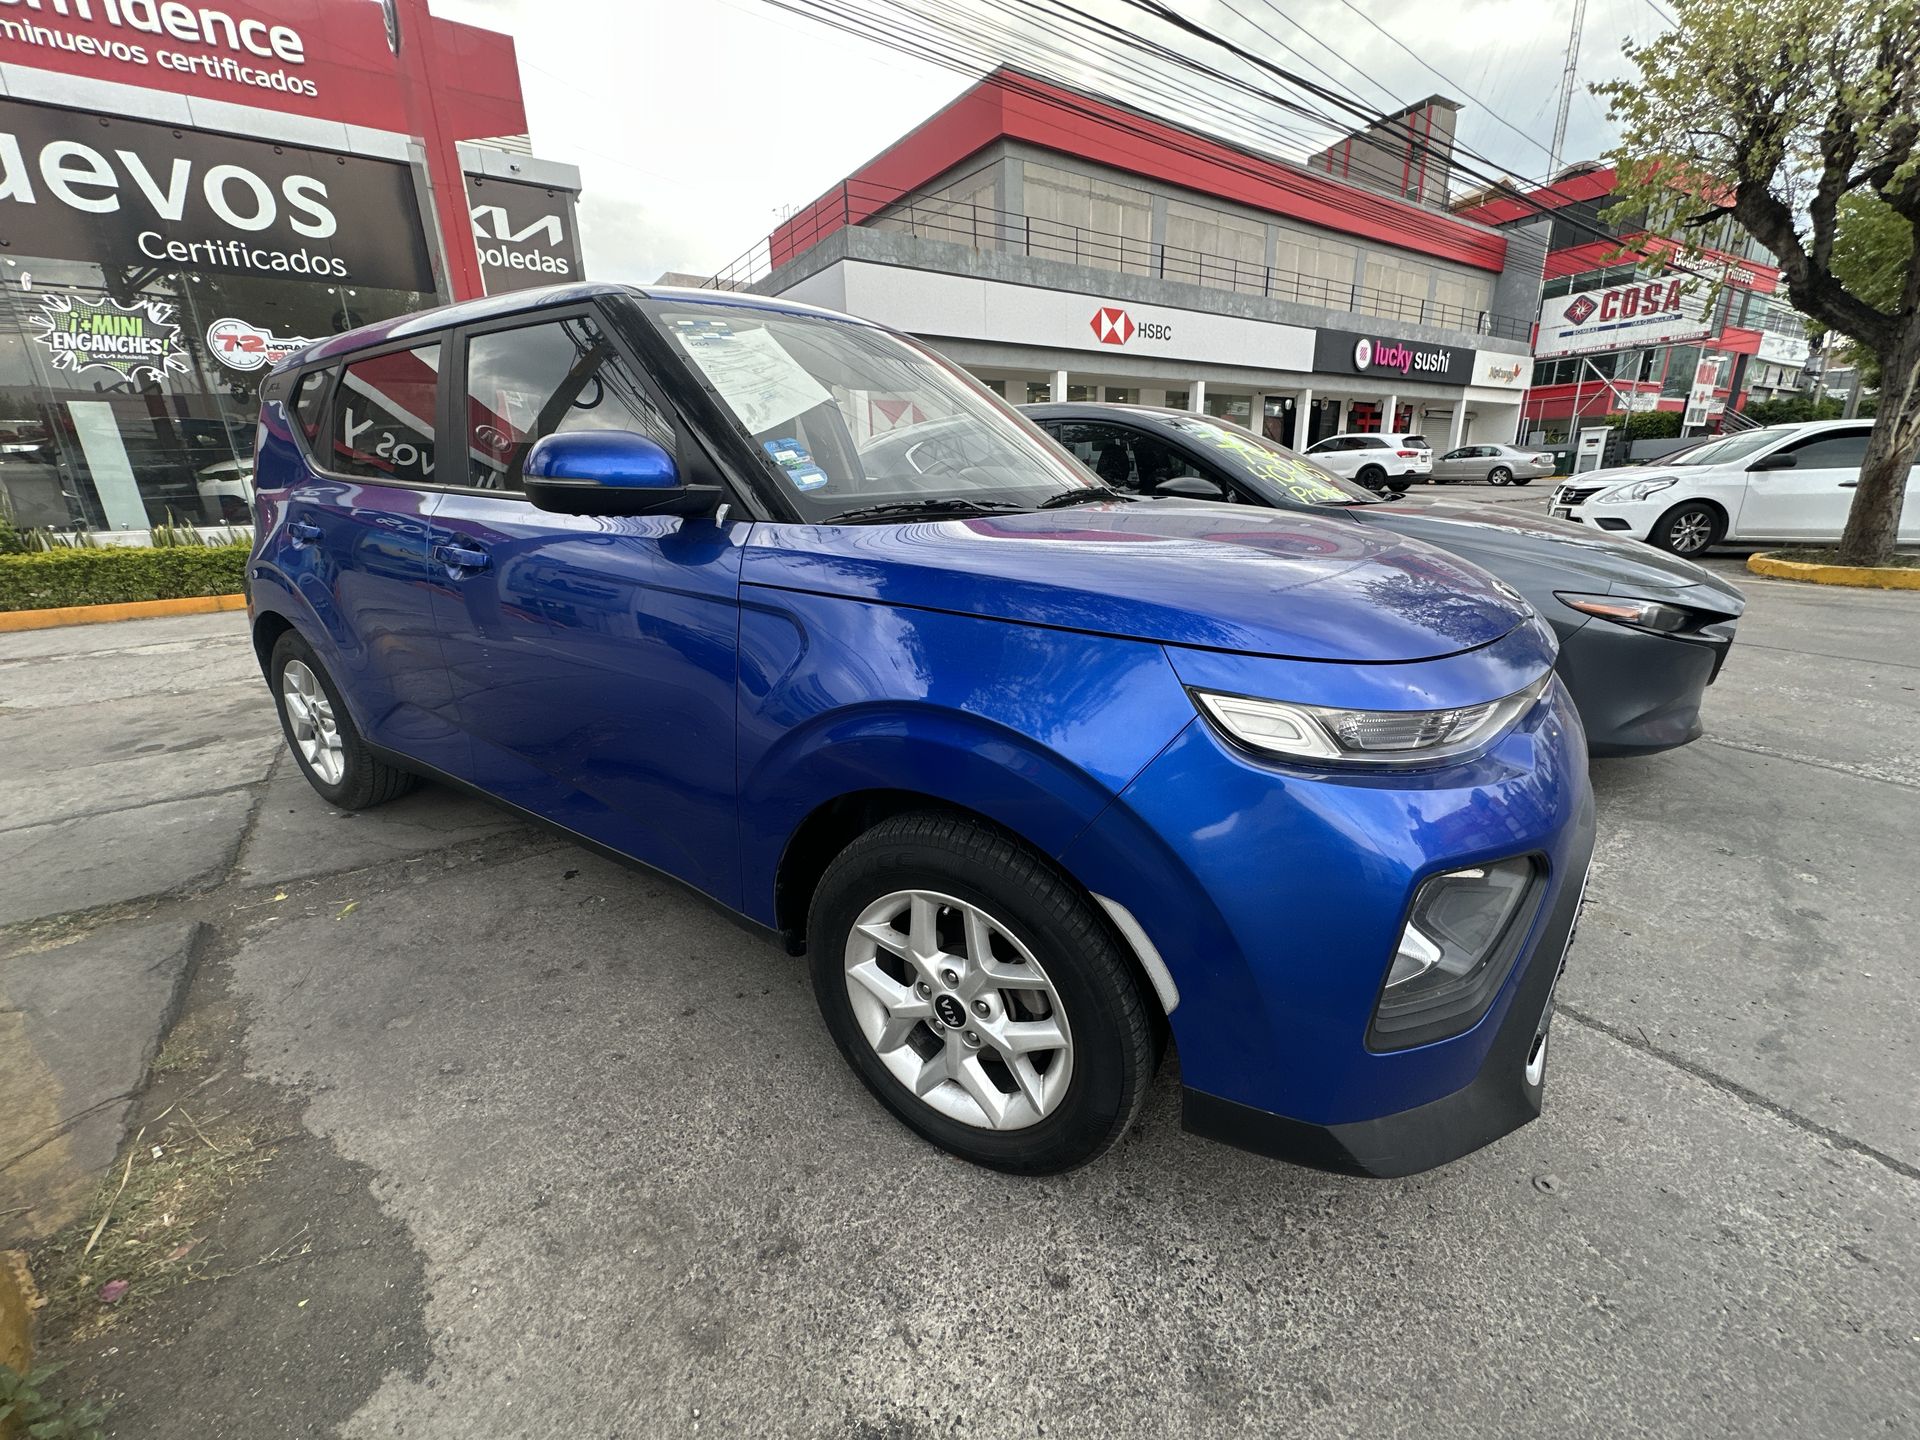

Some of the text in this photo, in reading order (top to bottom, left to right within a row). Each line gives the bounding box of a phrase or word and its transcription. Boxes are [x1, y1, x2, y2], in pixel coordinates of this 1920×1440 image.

[0, 0, 304, 63] idence
[156, 50, 319, 97] certificados
[138, 231, 347, 277] Certificados
[1599, 280, 1681, 322] COSA
[53, 332, 170, 356] ENGANCHES!
[215, 334, 266, 352] 72
[1138, 322, 1172, 341] HSBC
[1374, 340, 1451, 375] lucky sushi
[941, 998, 960, 1026] KIA
